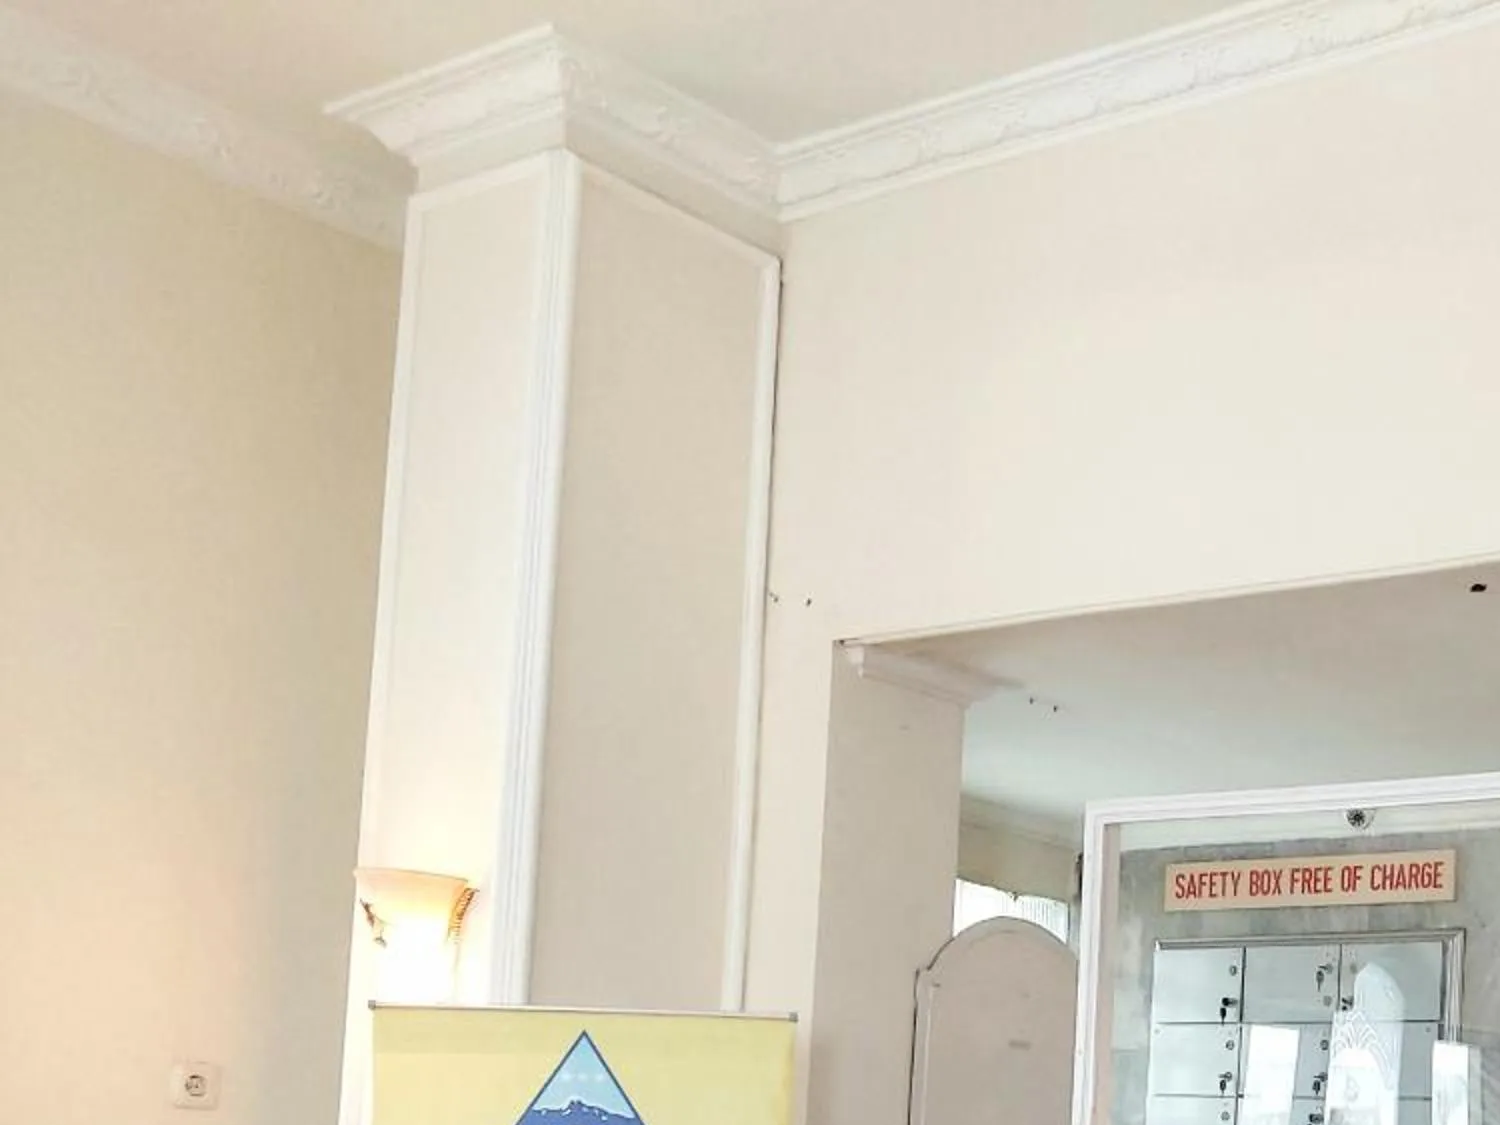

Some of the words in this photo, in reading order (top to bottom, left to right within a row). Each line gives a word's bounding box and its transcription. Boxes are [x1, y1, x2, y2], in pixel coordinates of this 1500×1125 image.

[1175, 871, 1241, 899] SAFETY
[1249, 869, 1283, 897] BOX
[1289, 866, 1334, 895] FREE
[1340, 865, 1363, 893] OF
[1370, 861, 1444, 891] CHARGE
